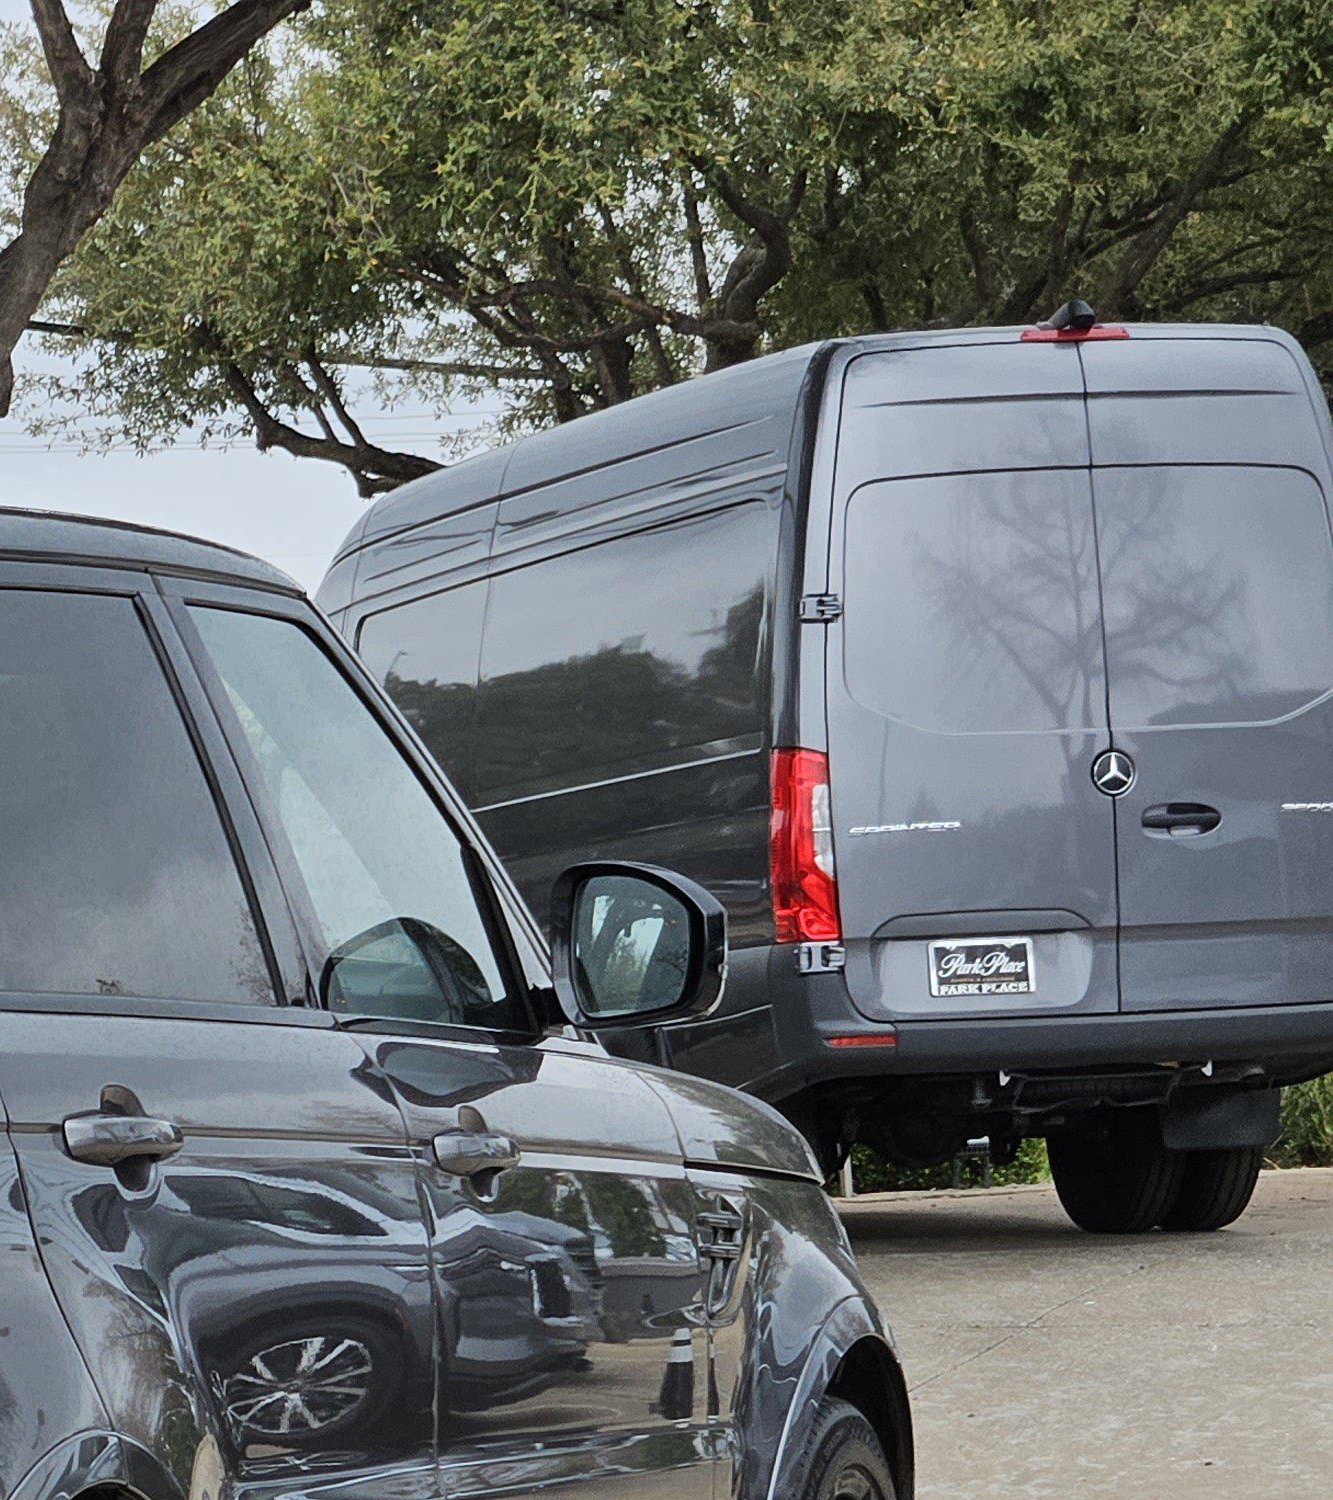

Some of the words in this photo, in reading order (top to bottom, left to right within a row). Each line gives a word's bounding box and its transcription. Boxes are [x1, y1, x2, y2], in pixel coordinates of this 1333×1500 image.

[938, 953, 983, 978] Park
[980, 951, 1026, 977] Place
[940, 983, 980, 996] PARK
[981, 981, 1028, 994] PLACE
